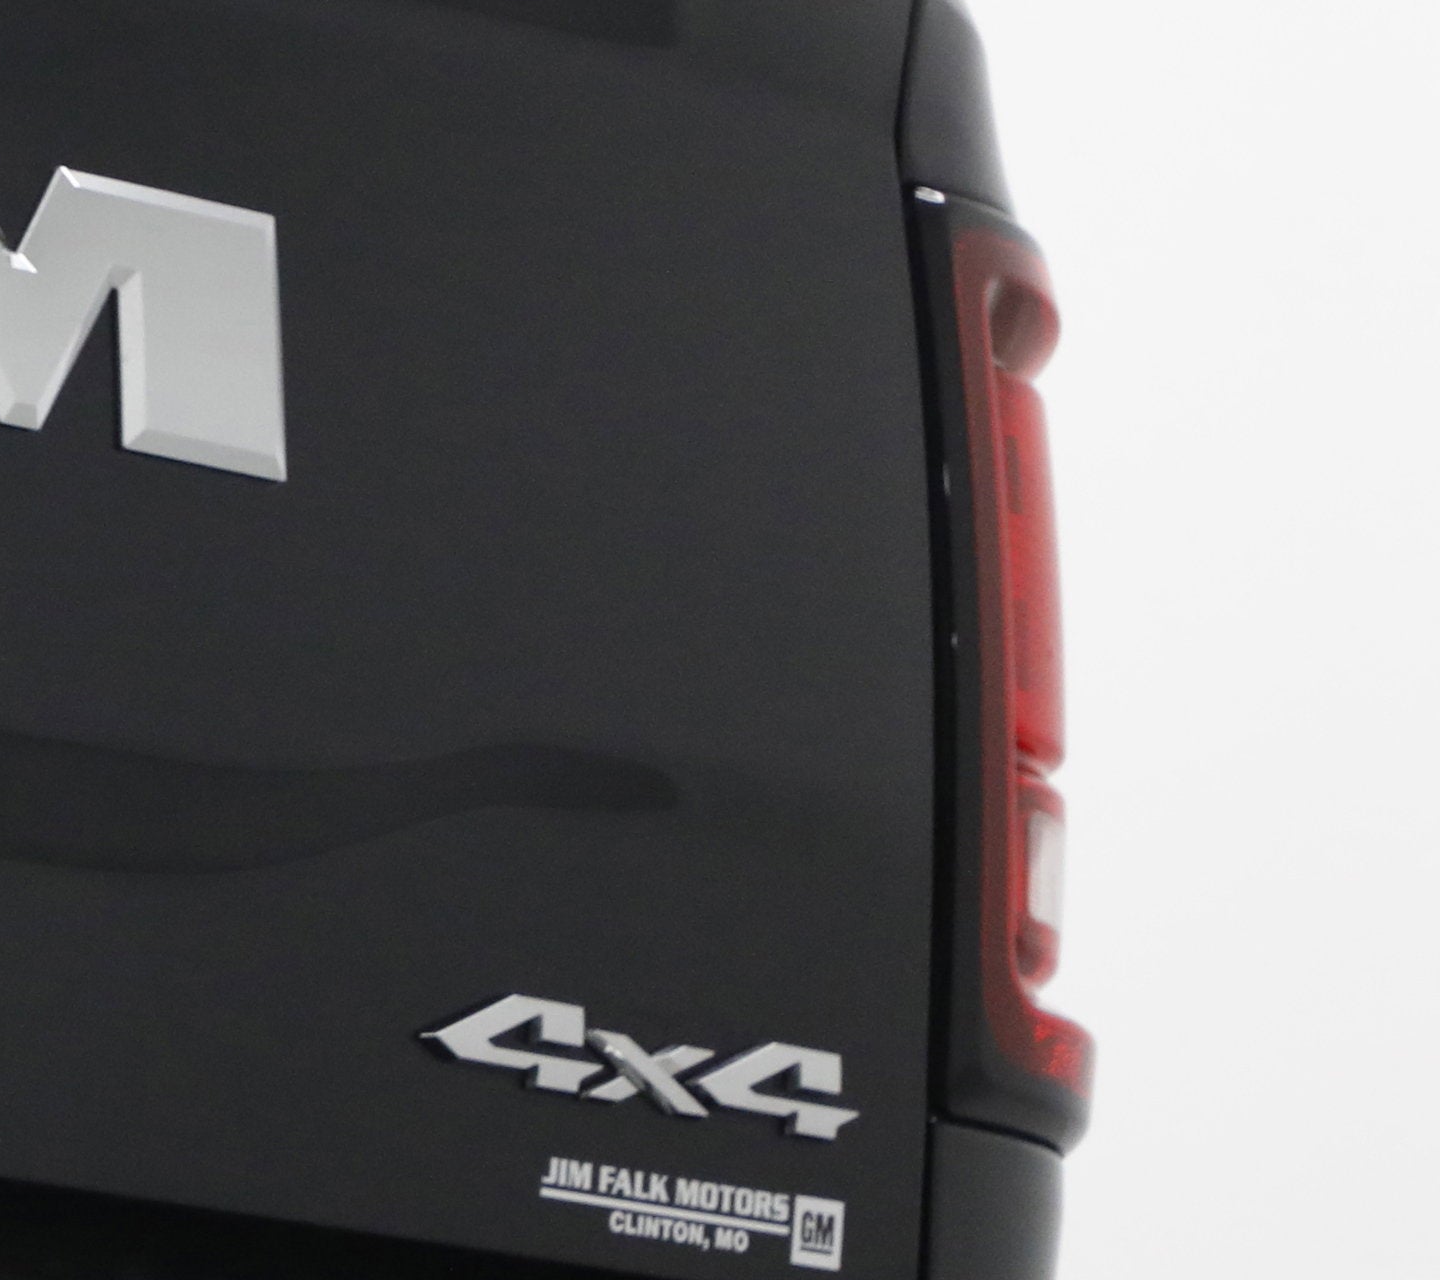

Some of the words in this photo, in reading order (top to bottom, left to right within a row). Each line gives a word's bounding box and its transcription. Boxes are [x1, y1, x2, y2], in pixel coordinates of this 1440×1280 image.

[541, 1156, 594, 1192] JIM
[597, 1164, 670, 1205] FALK
[674, 1176, 791, 1224] MOTORS
[608, 1208, 711, 1251] CLINTON,
[714, 1220, 751, 1254] MO
[799, 1209, 836, 1248] GM
